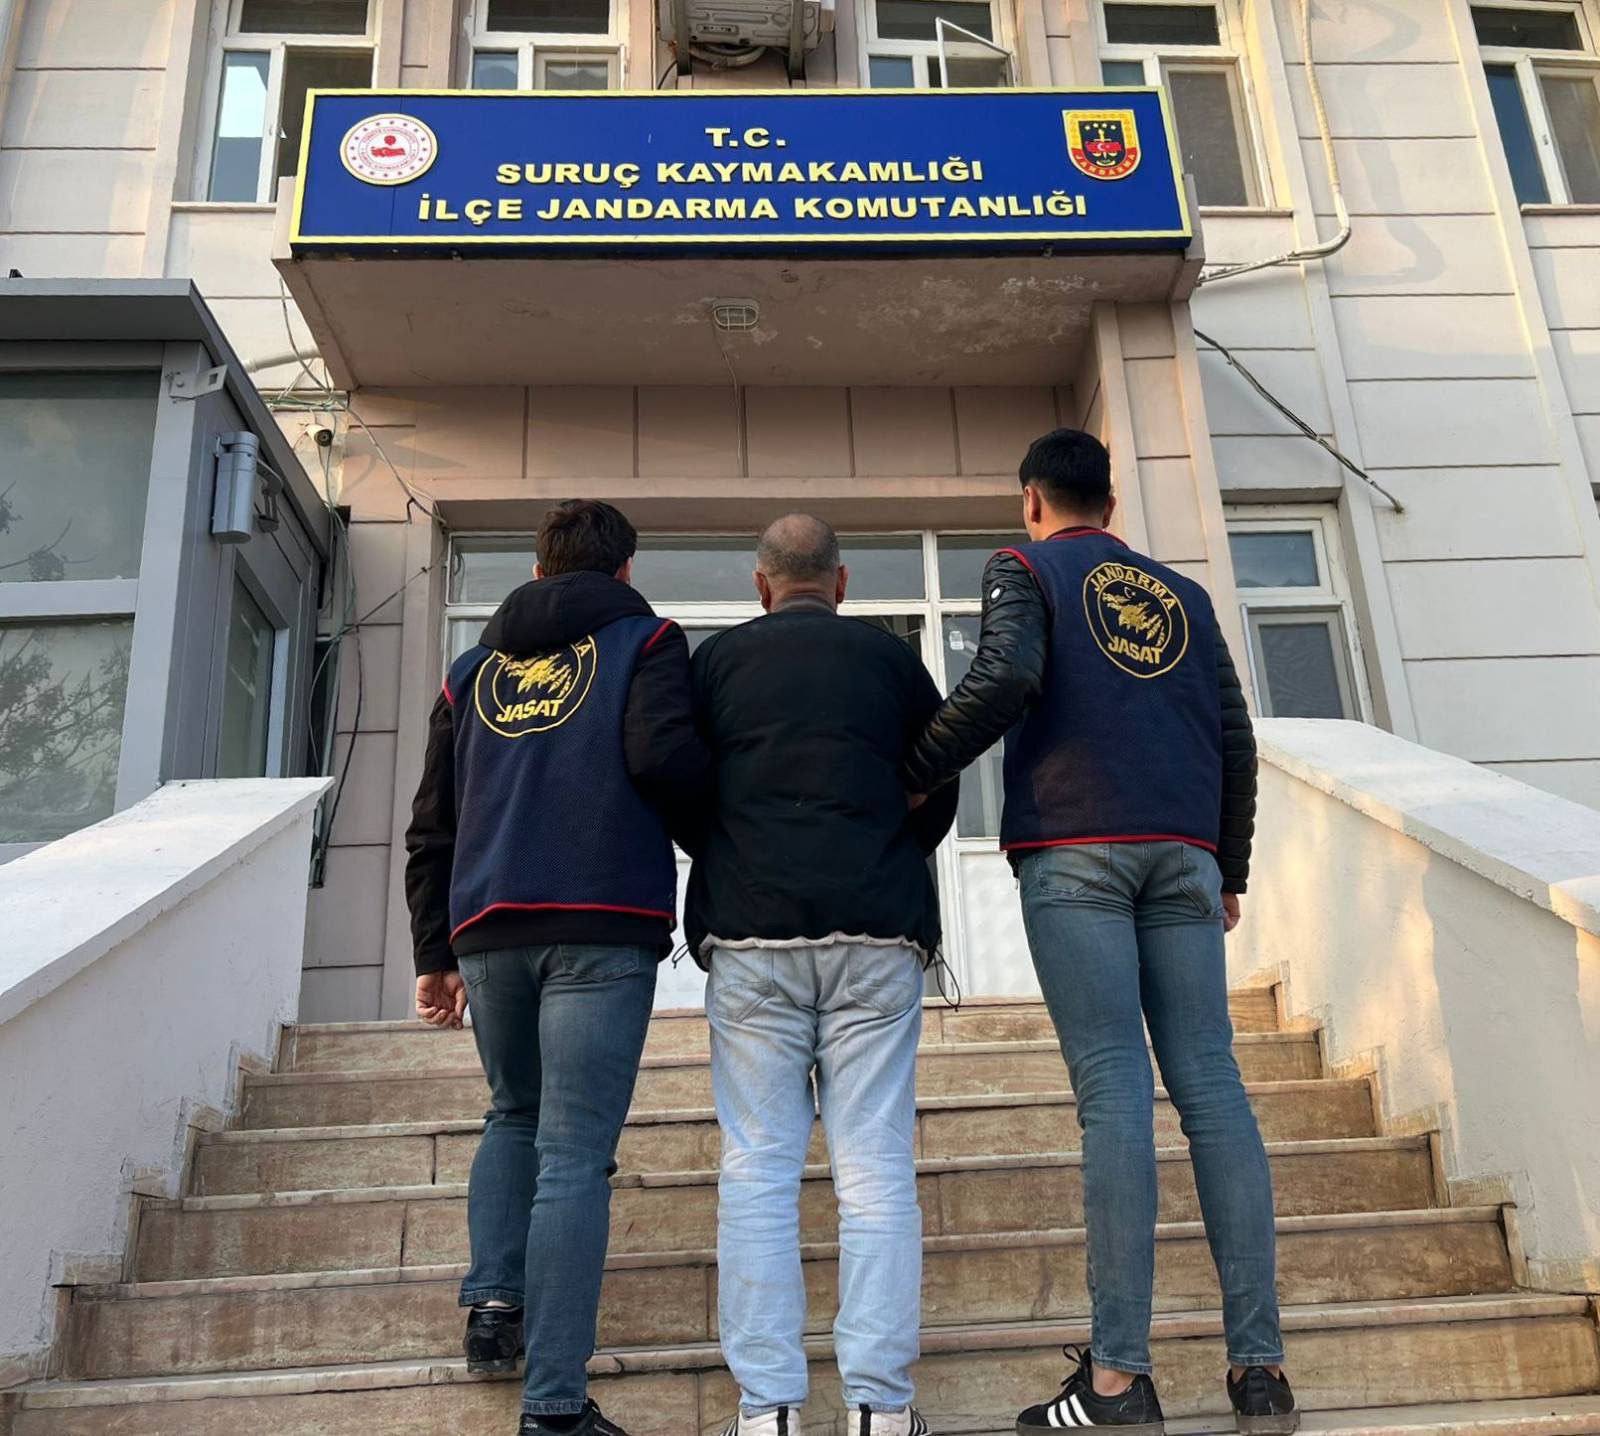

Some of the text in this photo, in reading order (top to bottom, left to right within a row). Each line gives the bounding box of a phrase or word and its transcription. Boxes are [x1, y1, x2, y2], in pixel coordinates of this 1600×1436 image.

[495, 156, 983, 189] SURUÇ KAYMAKAMLIĞI
[417, 190, 1087, 226] İLÇE JANDARMA KOMUTANLIĞI
[1090, 566, 1177, 610] JANDARMA
[1108, 636, 1162, 664] JASAT
[495, 698, 564, 723] JASAT
